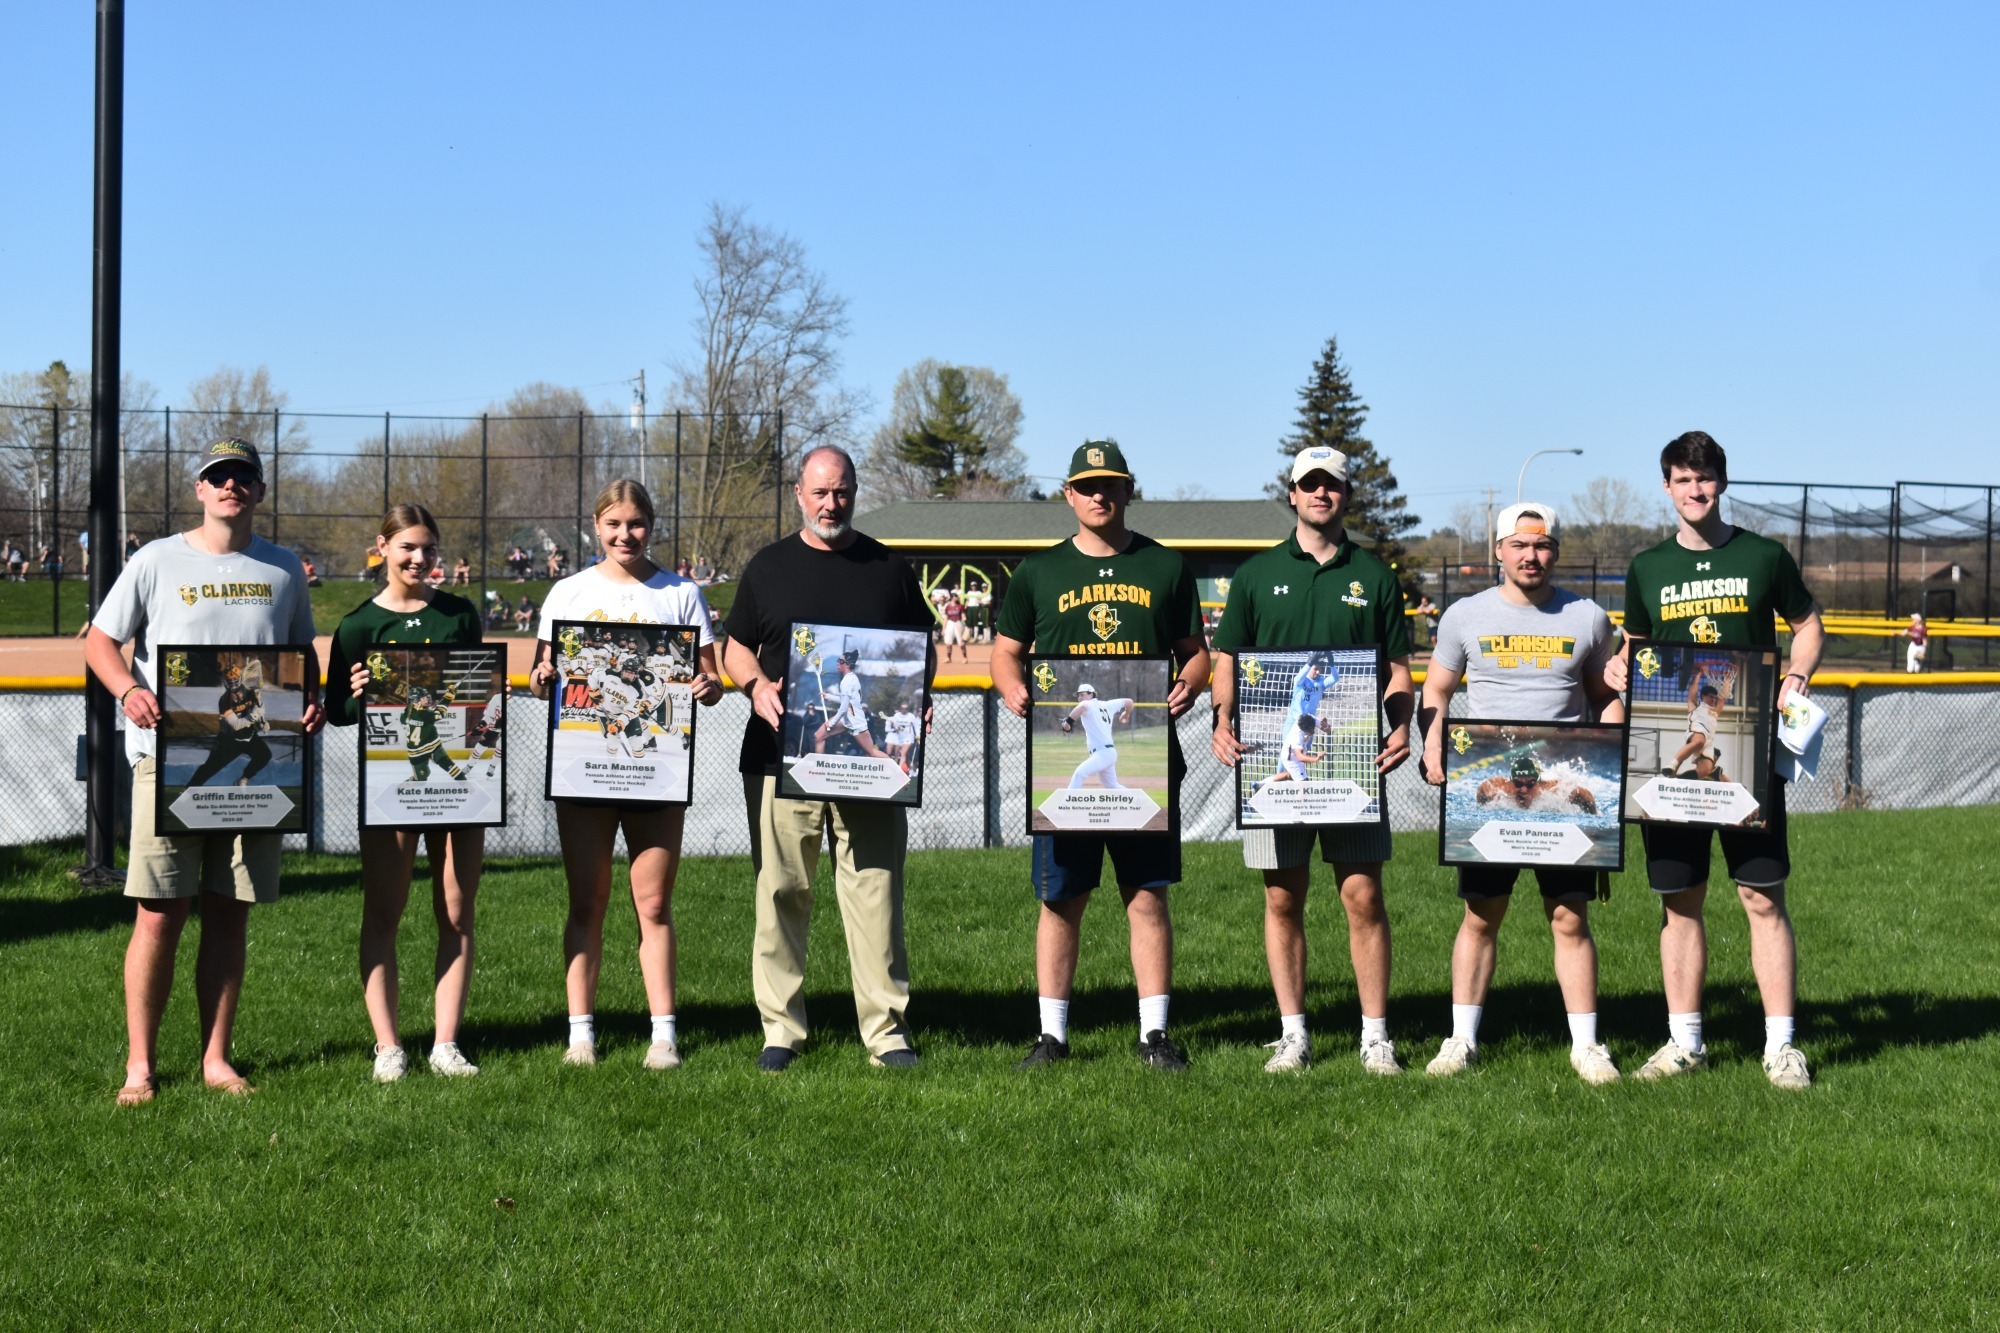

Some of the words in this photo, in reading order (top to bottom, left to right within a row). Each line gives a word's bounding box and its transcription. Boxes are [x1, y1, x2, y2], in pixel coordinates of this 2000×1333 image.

[201, 583, 273, 598] CLARKSON
[1661, 578, 1748, 605] CLARKSON
[225, 598, 274, 606] LACROSSE
[1058, 584, 1151, 613] CLARKSON
[1661, 598, 1748, 621] BASKETBALL
[1069, 642, 1142, 654] BASEBALL
[1497, 656, 1519, 668] SWIM
[585, 762, 608, 770] Sara
[611, 763, 655, 772] Manness
[816, 761, 847, 769] Maeve
[851, 763, 884, 771] Bartell
[425, 787, 469, 795] Manness
[1303, 787, 1352, 795] Kladstrup
[1658, 784, 1701, 794] Braeden
[1704, 788, 1735, 796] Burns
[192, 793, 224, 801] Griffin
[228, 792, 273, 800] Emerson
[1099, 795, 1133, 803] Shirley
